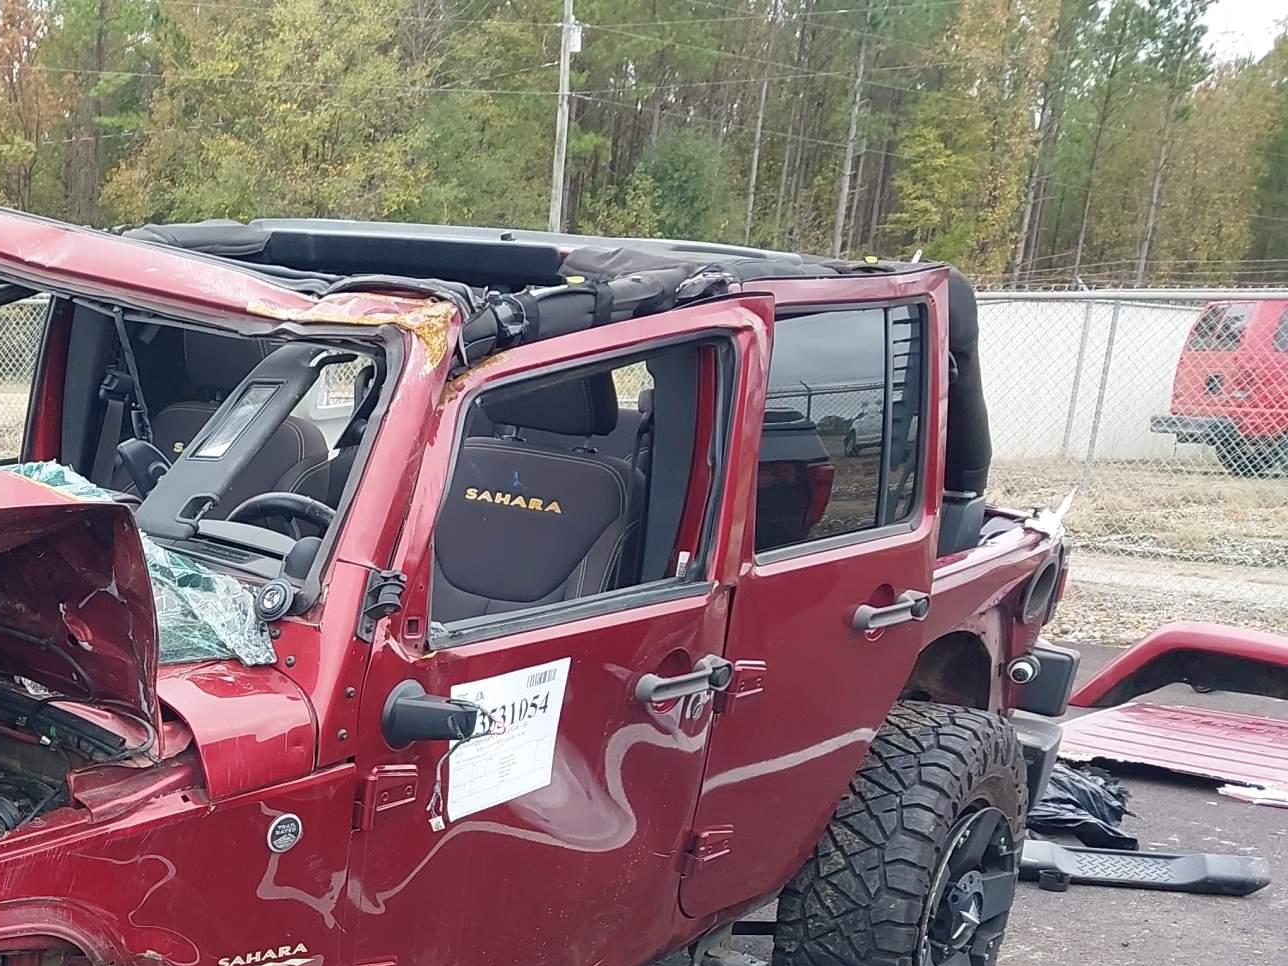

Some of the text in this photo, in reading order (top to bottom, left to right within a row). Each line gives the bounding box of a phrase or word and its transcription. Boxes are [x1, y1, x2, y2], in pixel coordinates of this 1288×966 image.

[465, 487, 562, 514] SAHARA
[477, 691, 550, 735] 3531054
[277, 822, 297, 831] TRAIL
